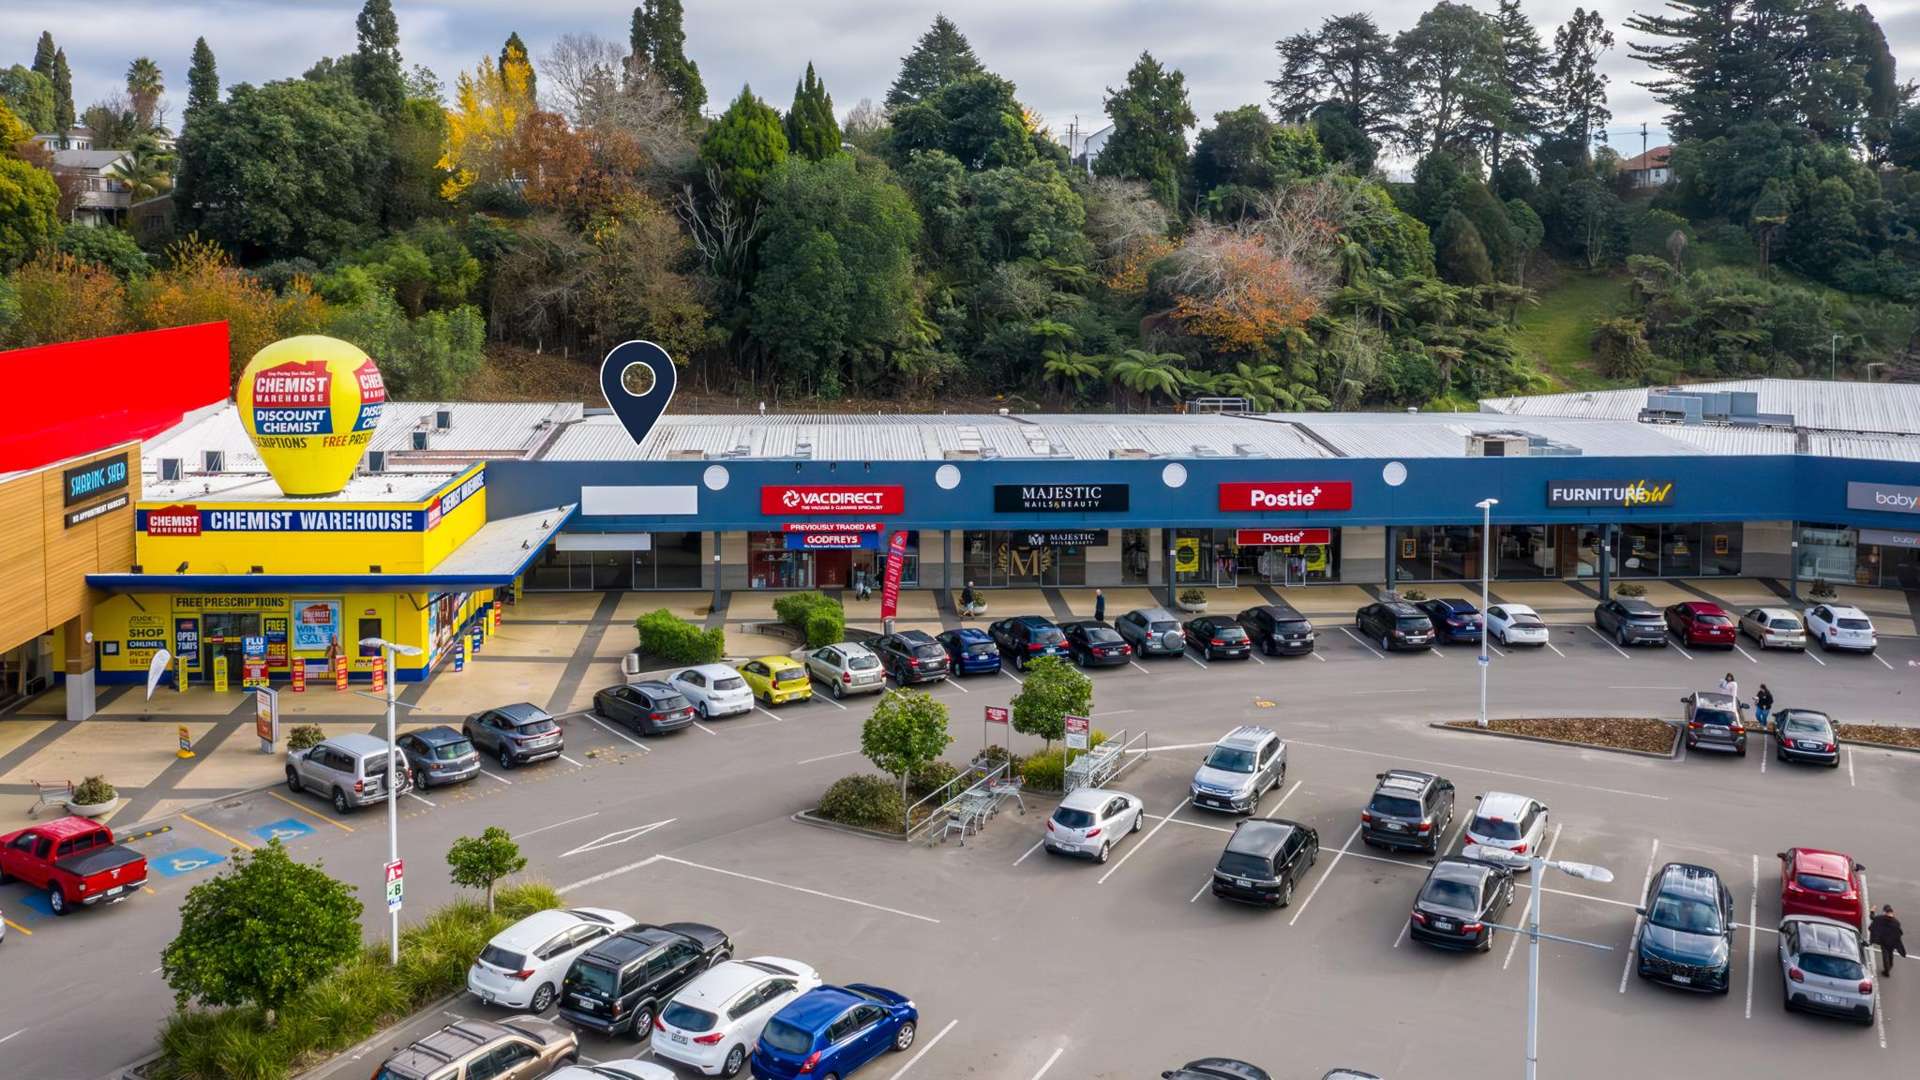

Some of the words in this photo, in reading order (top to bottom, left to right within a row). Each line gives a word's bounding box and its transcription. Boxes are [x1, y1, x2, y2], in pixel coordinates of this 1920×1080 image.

[256, 377, 328, 393] CHEMIST
[256, 394, 323, 402] WAREHOUSE
[257, 410, 326, 421] DISCOUNT
[263, 422, 321, 433] CHEMIST
[322, 434, 348, 448] FREE
[801, 492, 884, 504] VACDIRECT
[1022, 486, 1102, 499] MAJESTIC
[150, 515, 199, 526] CHEMIST
[211, 511, 293, 530] CHEMIST
[300, 511, 413, 530] WAREHOUSE
[807, 535, 858, 544] GODFREYS
[1050, 533, 1095, 541] MAJESTIC
[175, 597, 202, 607] FREE
[204, 597, 284, 607] PRESCRIPTIONS
[129, 628, 164, 638] SHOP
[177, 632, 198, 641] OPEN
